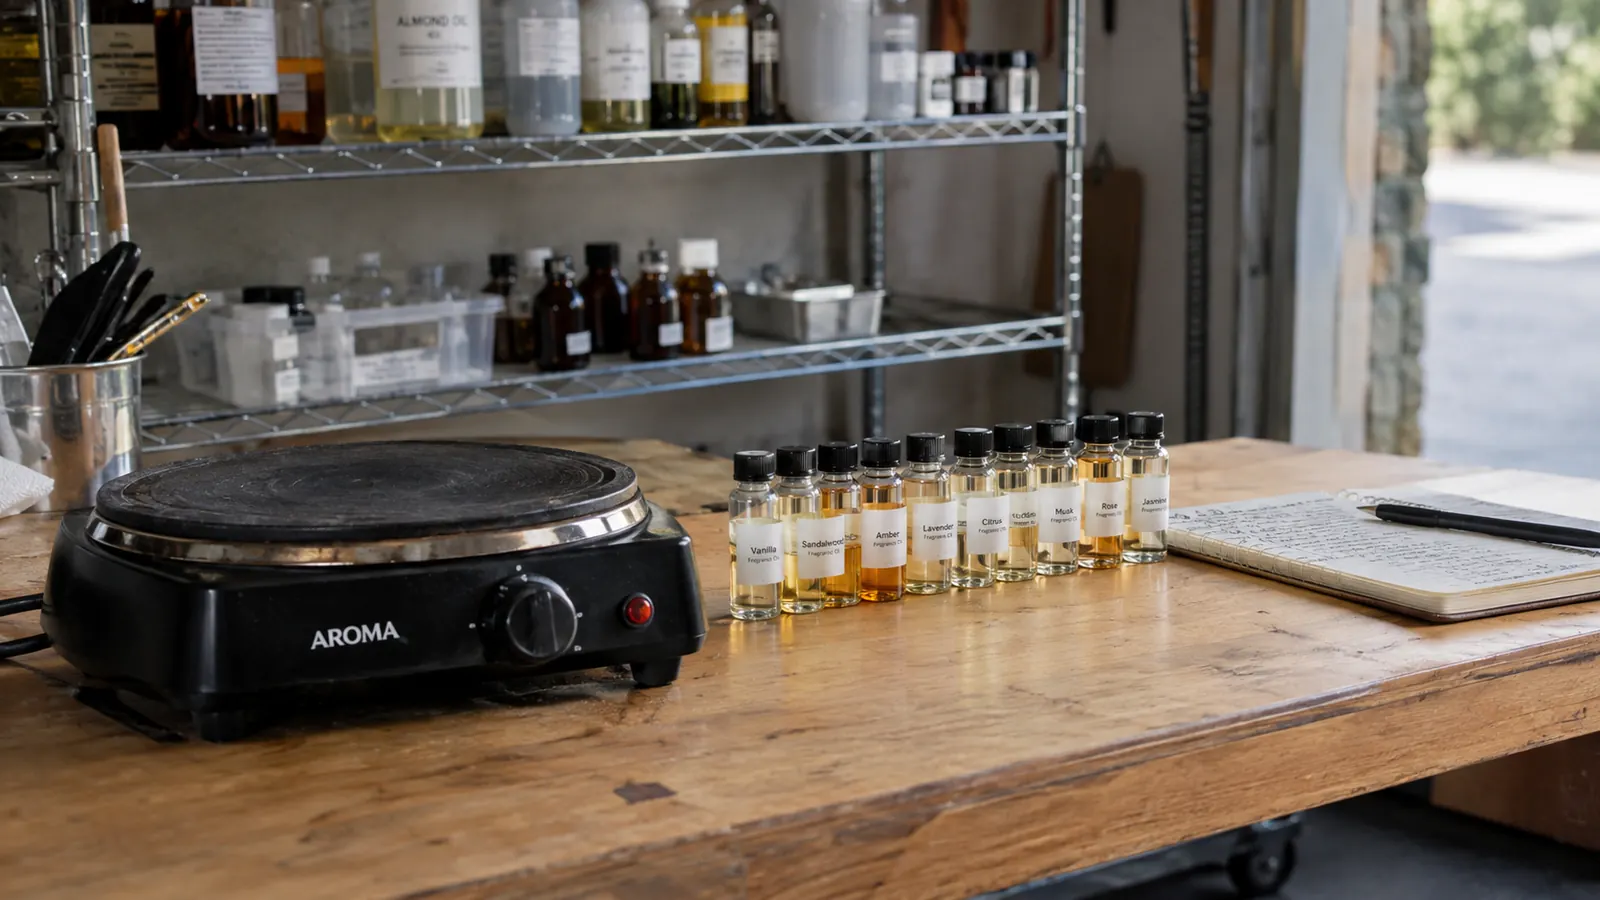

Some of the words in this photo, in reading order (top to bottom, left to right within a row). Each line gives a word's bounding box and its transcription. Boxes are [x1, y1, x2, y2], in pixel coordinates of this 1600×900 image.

[396, 15, 449, 27] ALMOND
[1101, 502, 1118, 511] Rose
[1142, 498, 1167, 506] Jasmine
[1055, 507, 1074, 515] Musk
[981, 518, 1003, 526] Citrus
[922, 524, 954, 533] Lavender
[875, 531, 901, 540] Amber
[750, 546, 777, 555] Vanilla
[311, 620, 400, 650] AROMA
